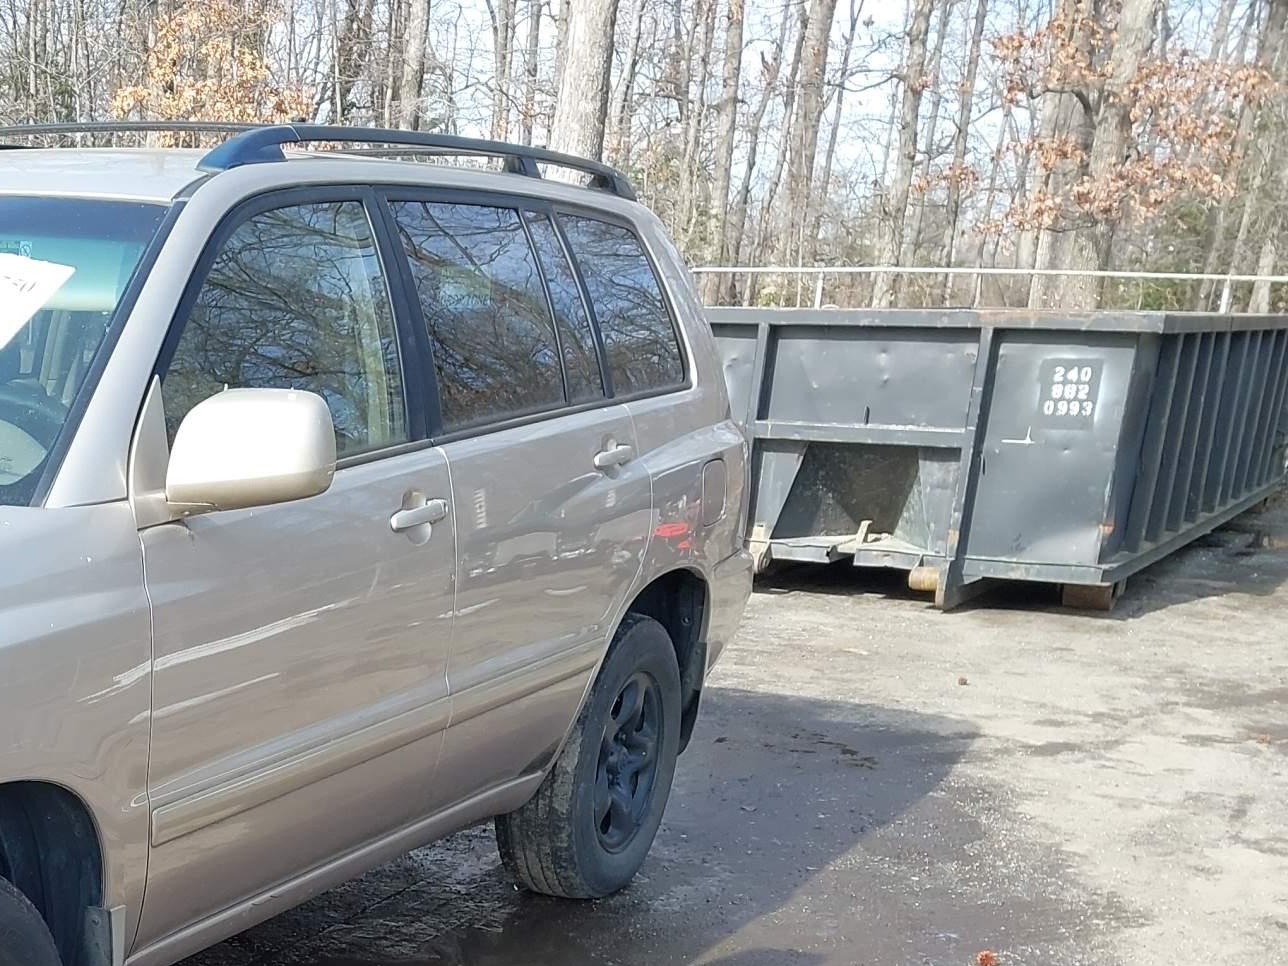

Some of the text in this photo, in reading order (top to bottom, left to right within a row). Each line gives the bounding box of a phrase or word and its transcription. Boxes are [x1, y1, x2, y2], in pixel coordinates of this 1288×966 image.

[1053, 366, 1092, 382] 240
[1051, 383, 1090, 400] 882
[1043, 400, 1093, 417] 0993
